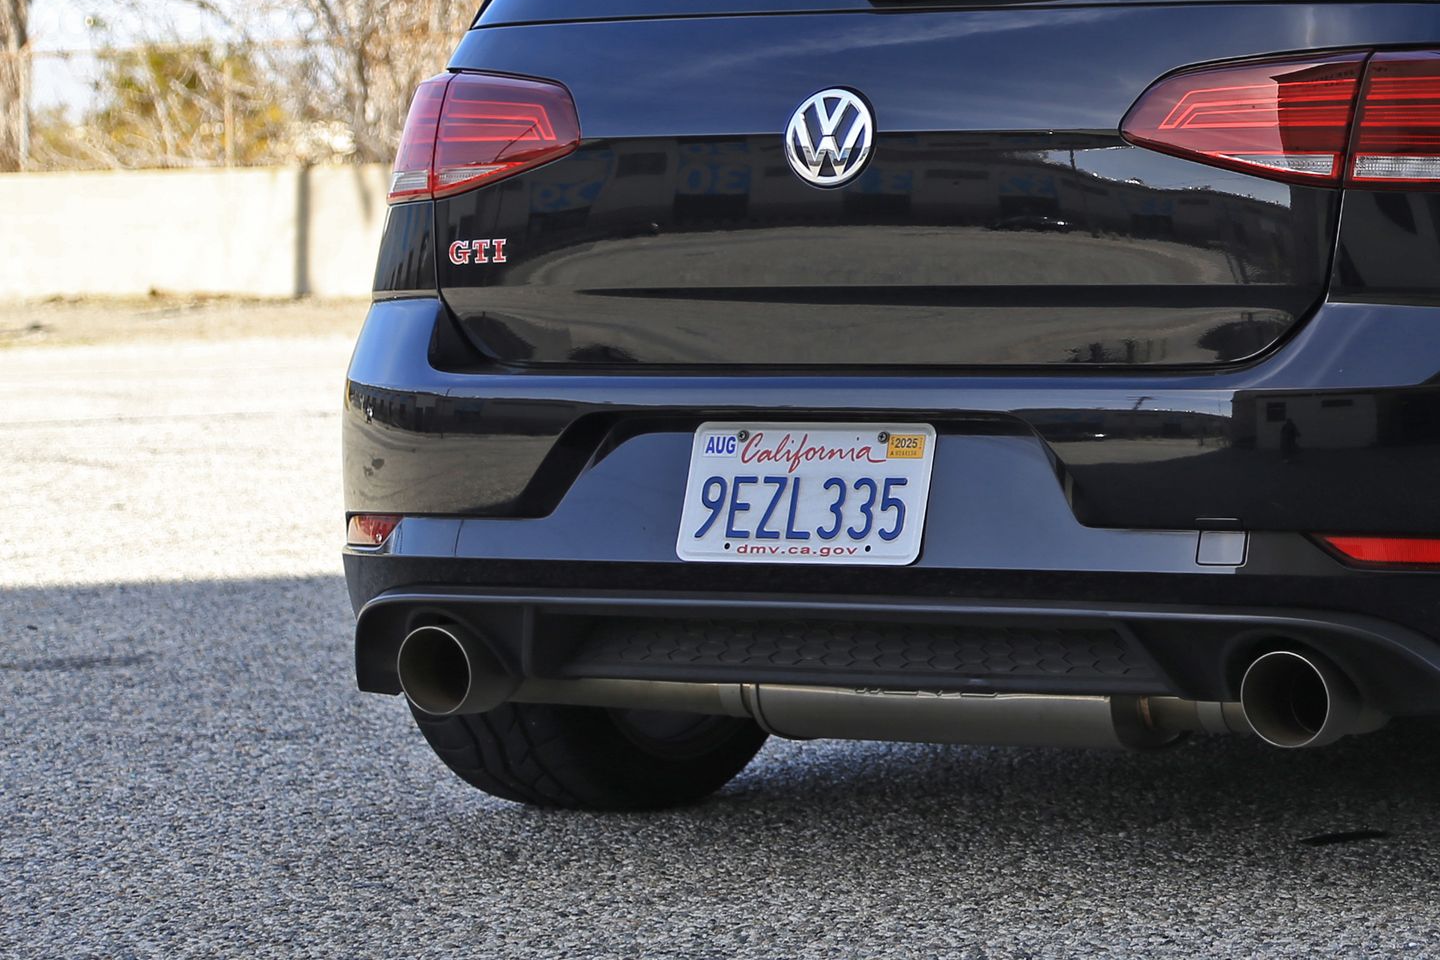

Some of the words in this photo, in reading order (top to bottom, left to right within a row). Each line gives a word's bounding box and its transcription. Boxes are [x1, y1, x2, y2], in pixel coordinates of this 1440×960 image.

[786, 89, 872, 183] VW
[448, 239, 507, 265] GTI
[705, 436, 737, 454] AUG
[741, 432, 887, 473] California
[894, 437, 919, 449] 2025
[694, 475, 908, 541] 9EZL335
[736, 544, 858, 557] dmv.ca.gov
